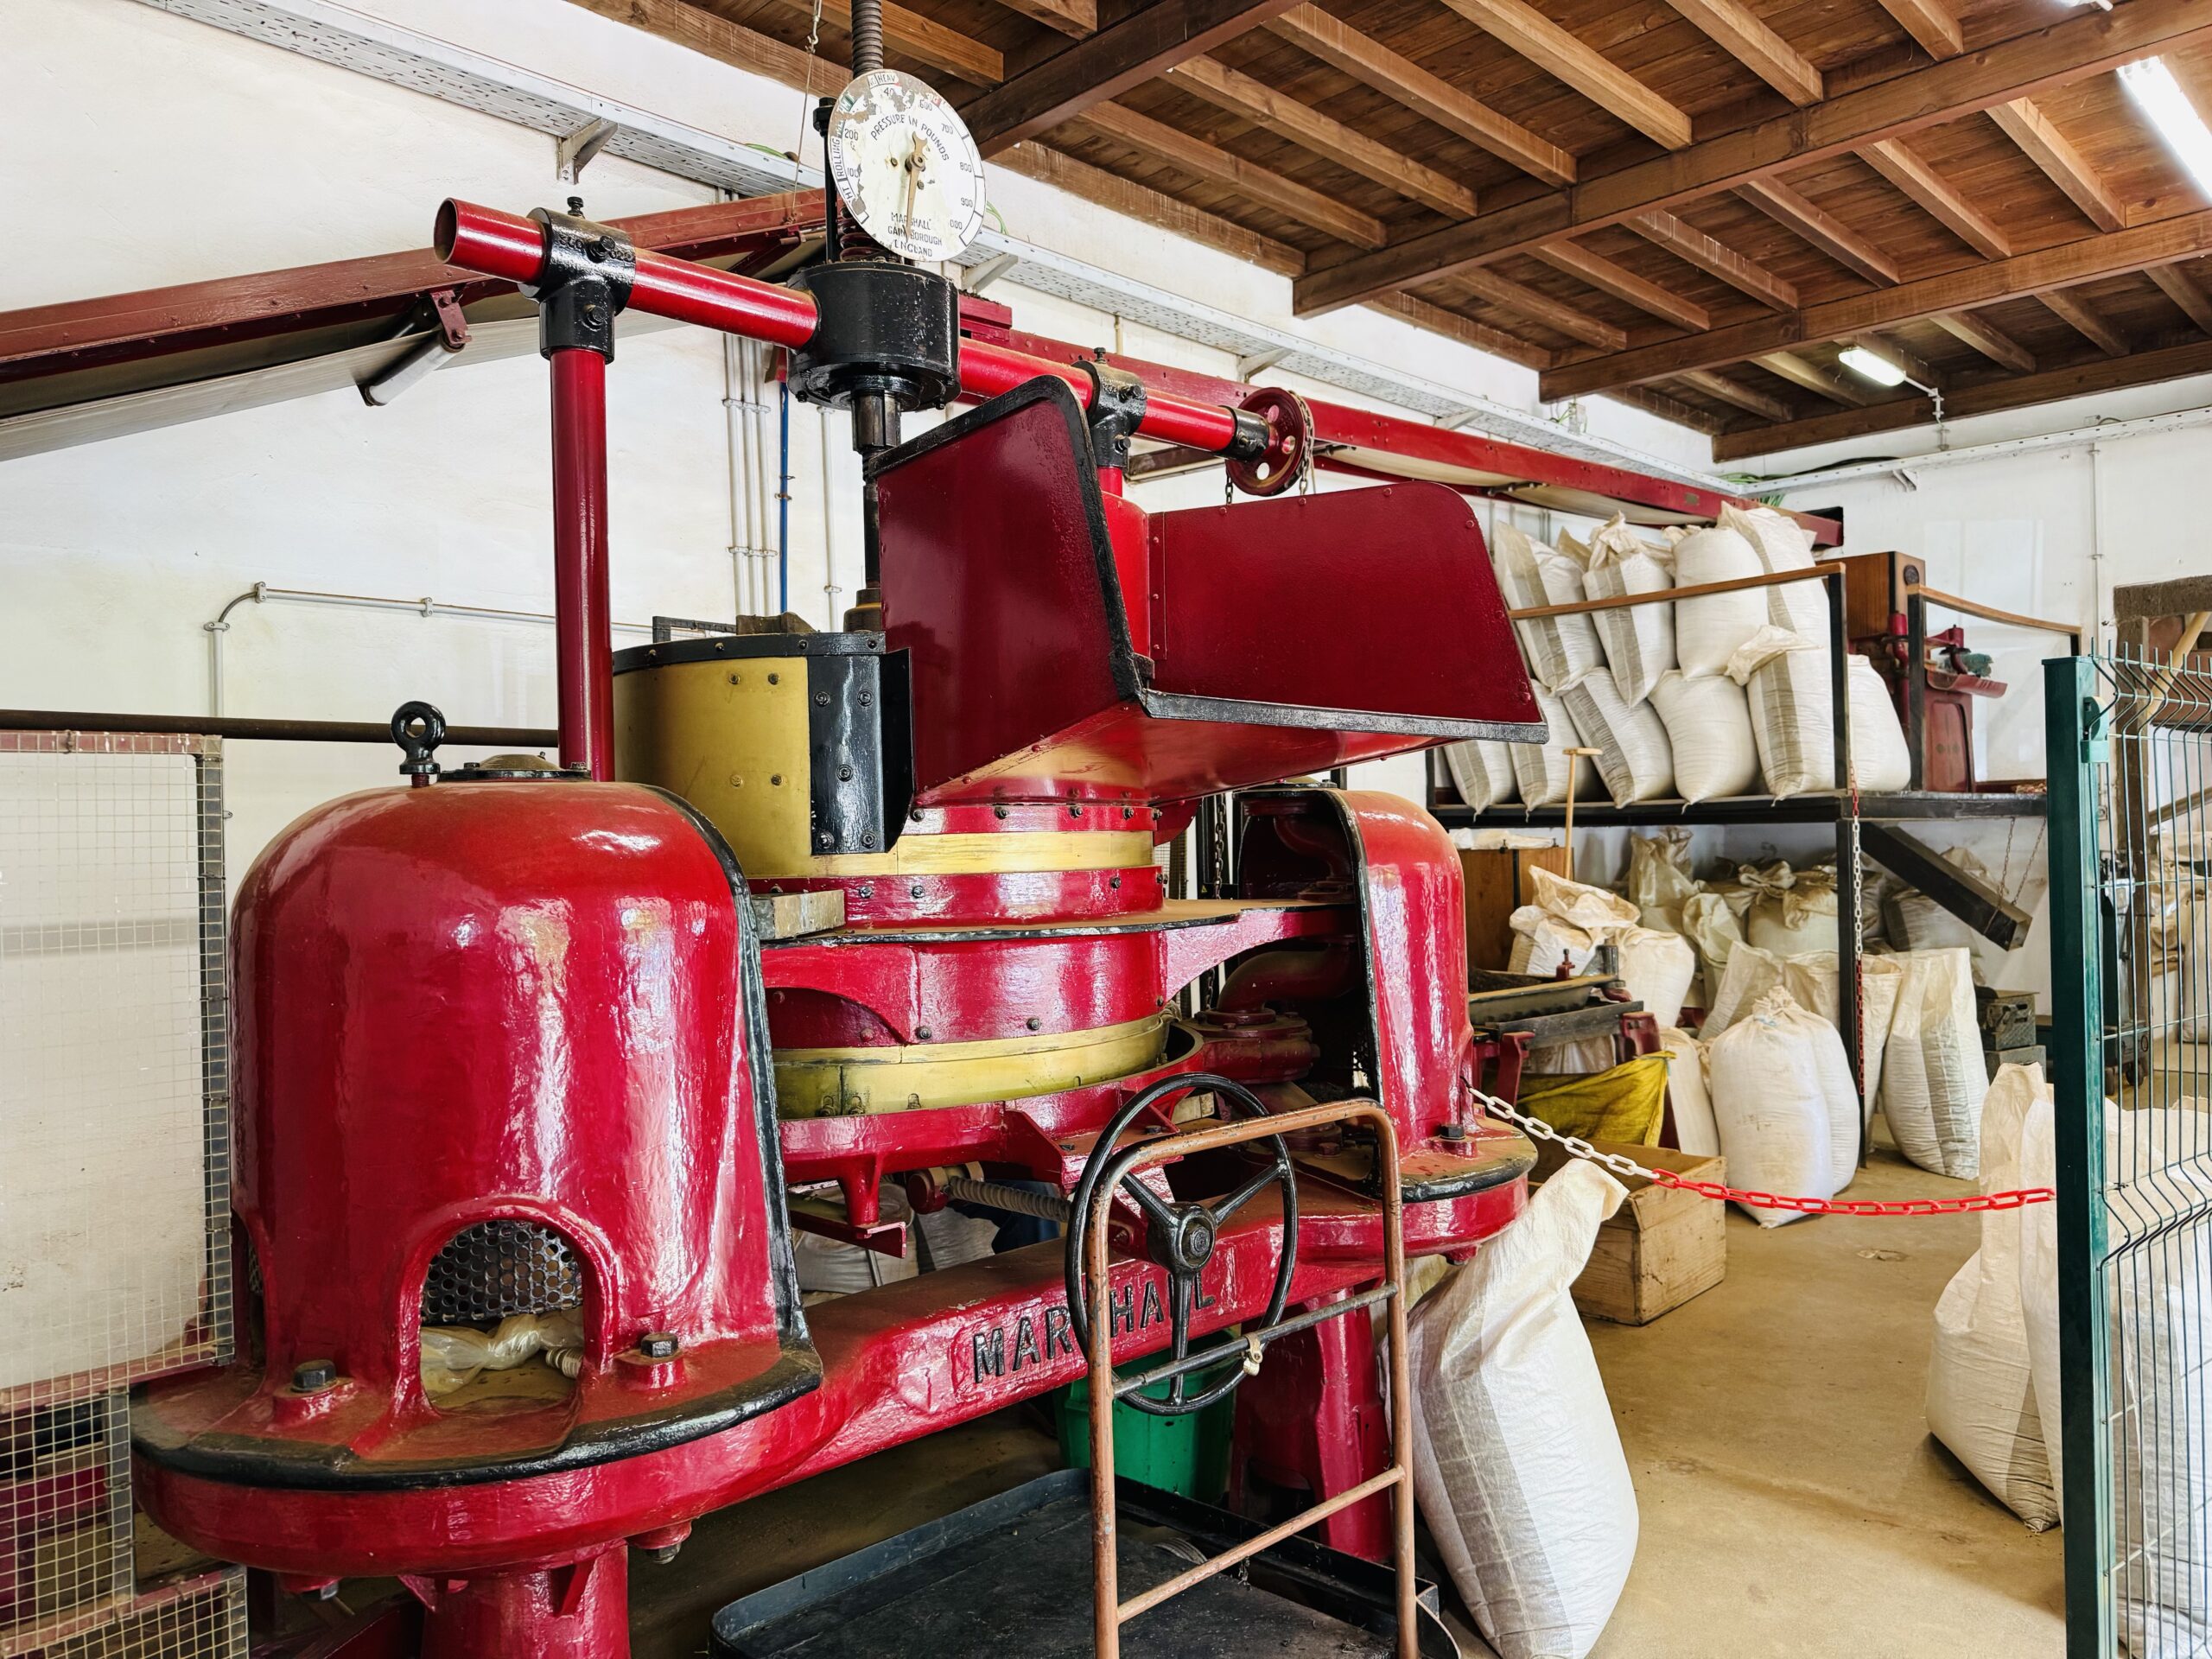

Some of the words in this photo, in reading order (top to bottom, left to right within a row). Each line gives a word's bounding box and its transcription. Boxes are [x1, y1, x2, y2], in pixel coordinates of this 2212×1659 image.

[844, 129, 858, 141] 200
[941, 124, 953, 135] 700
[871, 115, 905, 141] PRESSURE
[908, 117, 918, 127] IN
[921, 124, 949, 161] POUNDS
[960, 162, 971, 172] 800
[961, 198, 973, 207] 900
[974, 1272, 1215, 1383] MARHAL
